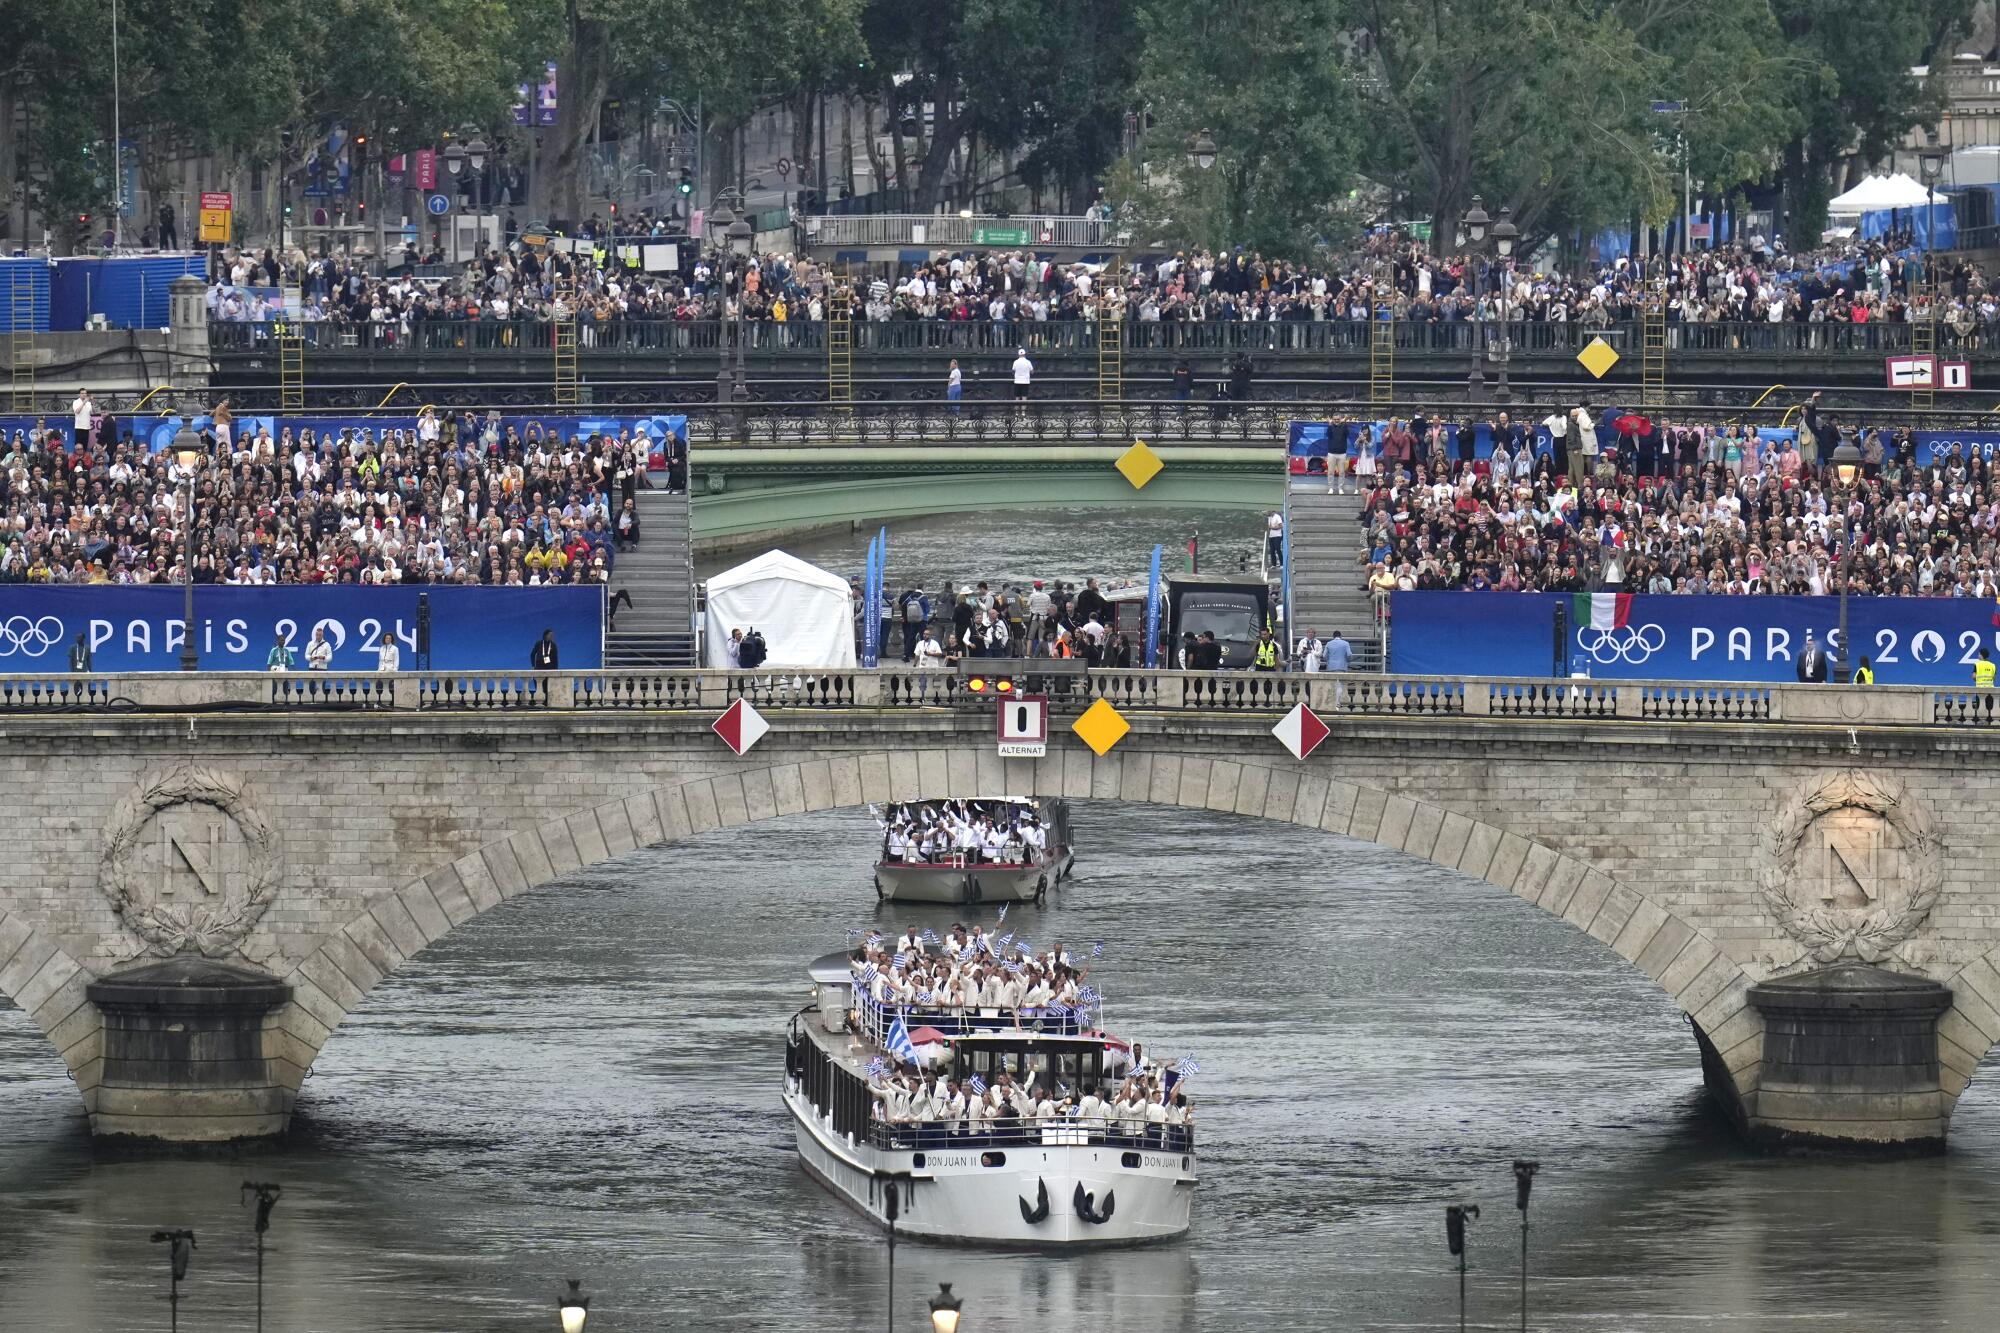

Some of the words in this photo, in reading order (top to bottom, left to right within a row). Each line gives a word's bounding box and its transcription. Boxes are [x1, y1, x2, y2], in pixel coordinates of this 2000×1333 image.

[422, 153, 430, 183] PARIS
[1875, 628, 2000, 664] 202
[161, 822, 221, 895] N
[1821, 829, 1880, 901] N
[927, 1156, 942, 1167] DON
[944, 1156, 967, 1167] JUAN
[1144, 1156, 1161, 1167] DON
[1162, 1157, 1177, 1168] JUAN
